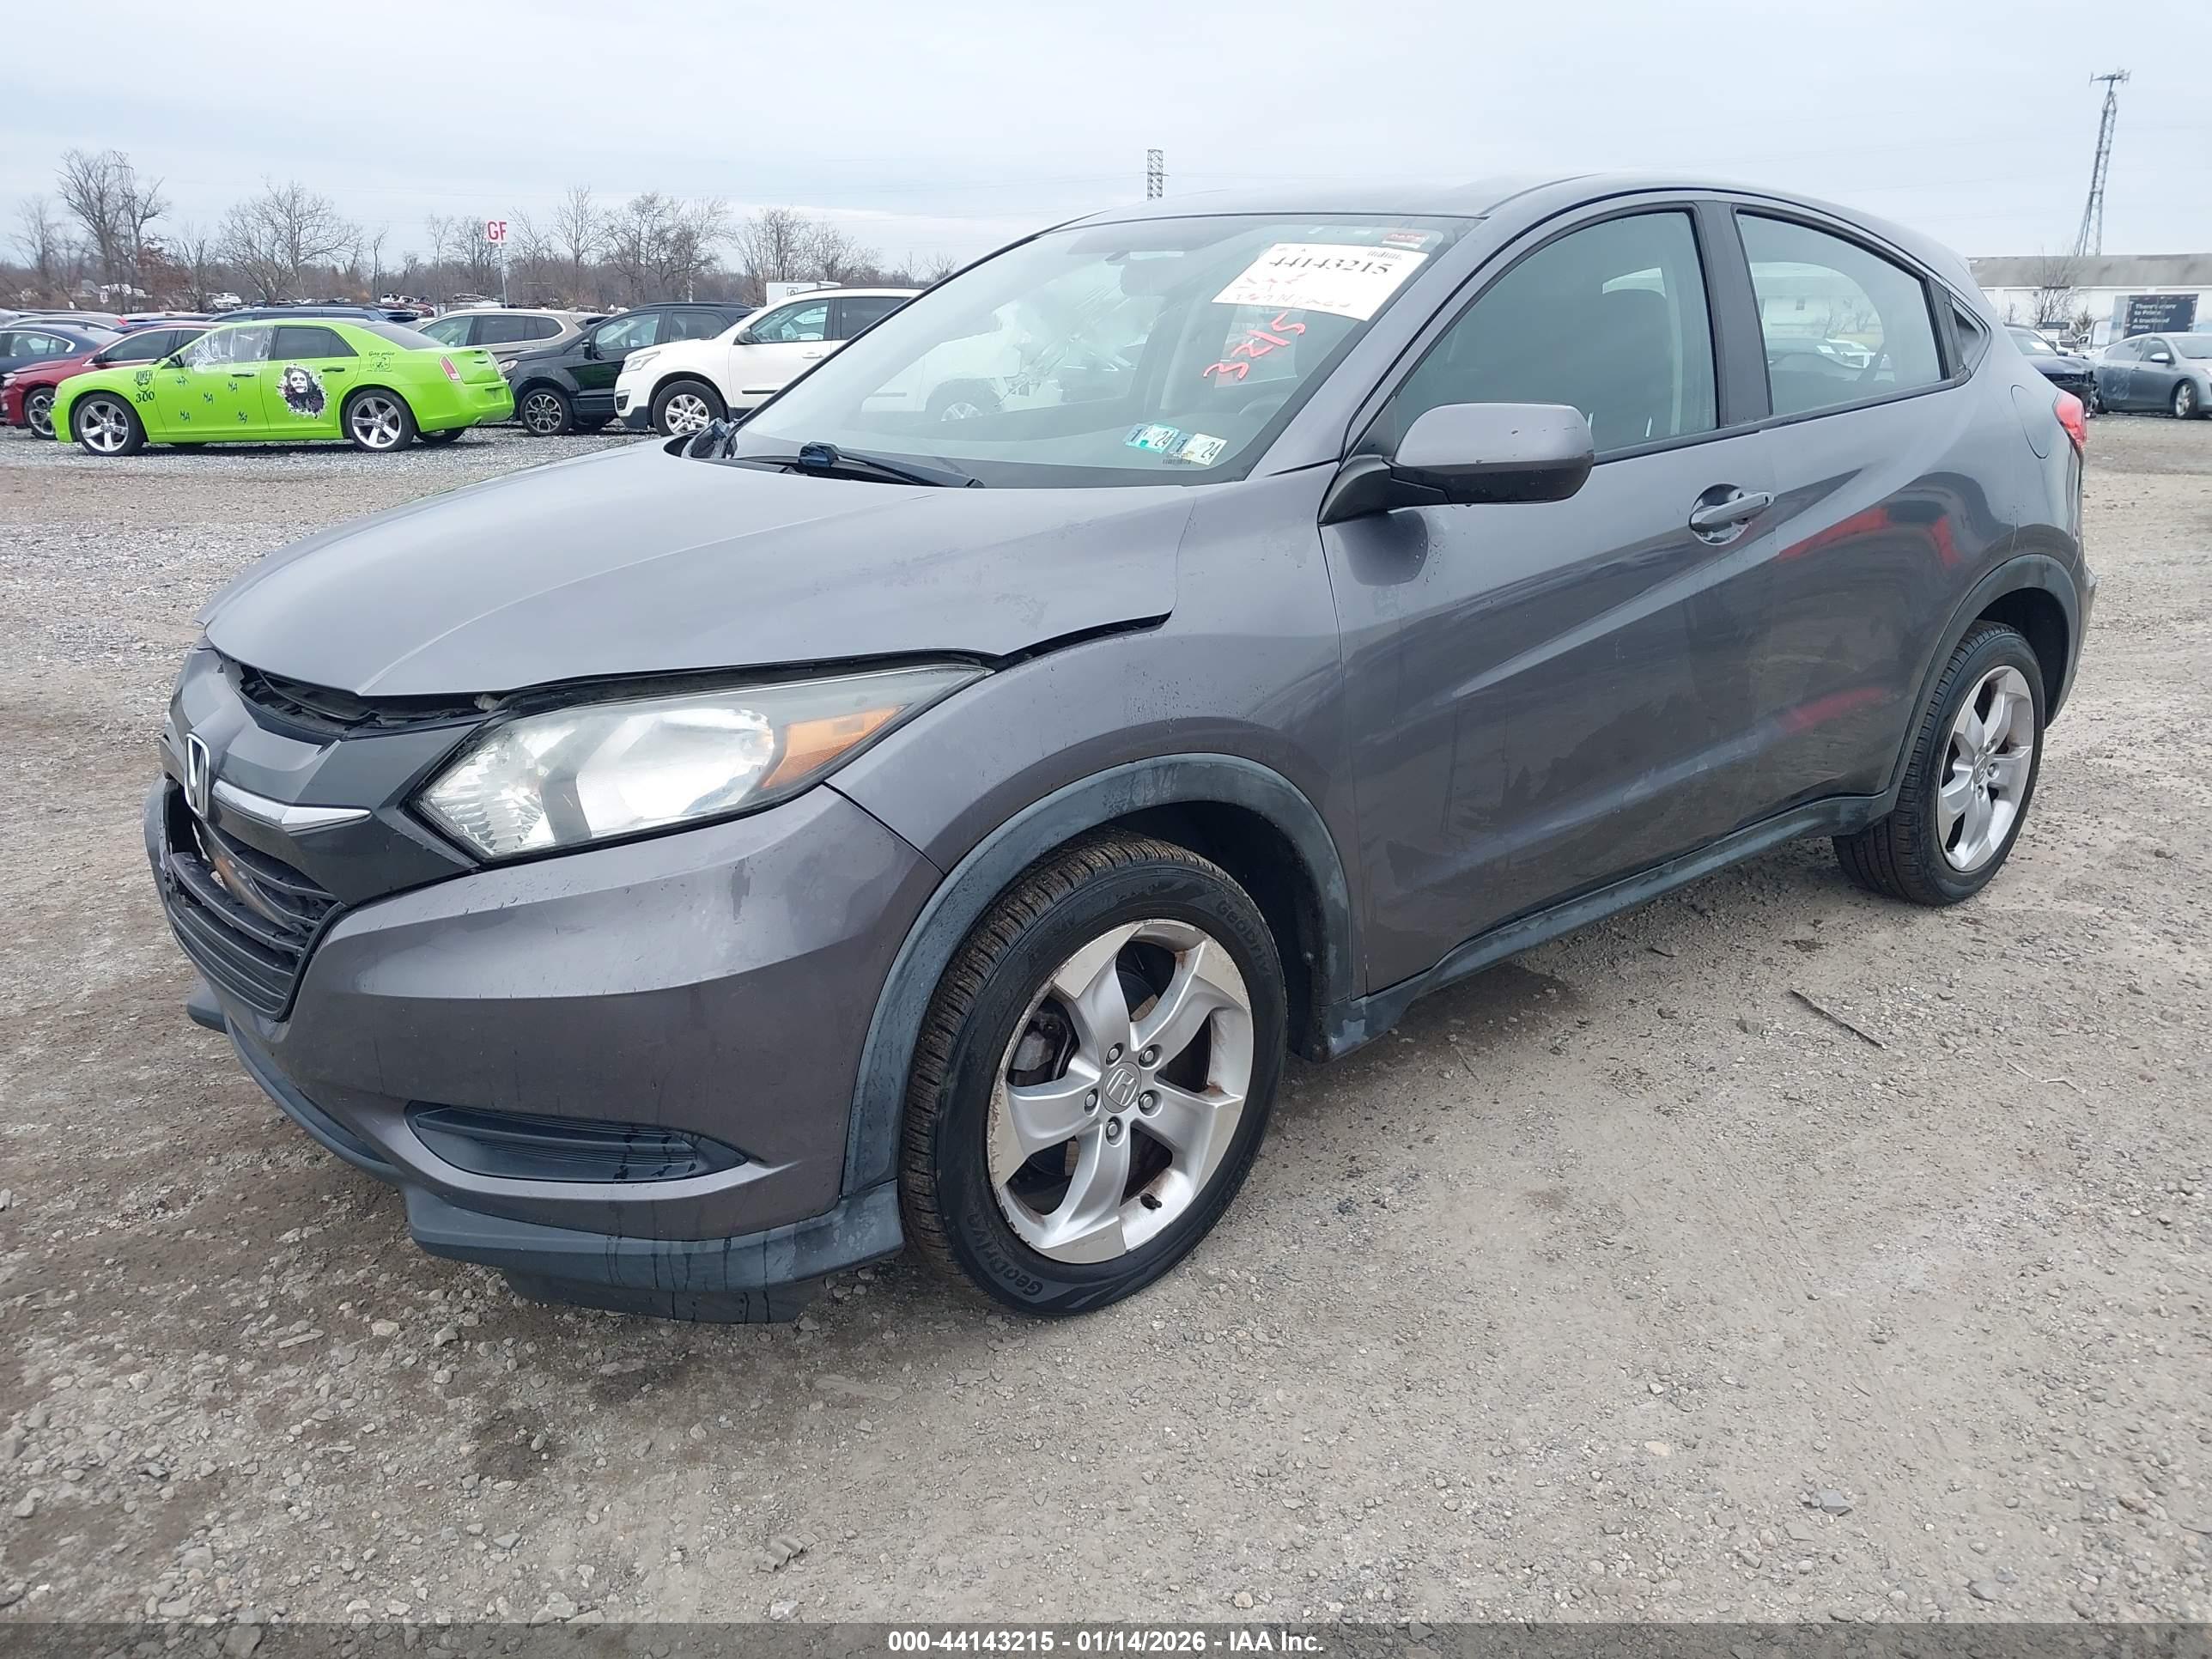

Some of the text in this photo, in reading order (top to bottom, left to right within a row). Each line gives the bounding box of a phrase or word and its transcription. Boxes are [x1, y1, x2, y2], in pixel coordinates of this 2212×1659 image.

[487, 221, 507, 241] GF
[1268, 256, 1394, 276] 44143215
[134, 369, 153, 382] JOKER
[136, 391, 155, 404] 300
[1200, 441, 1221, 460] 24
